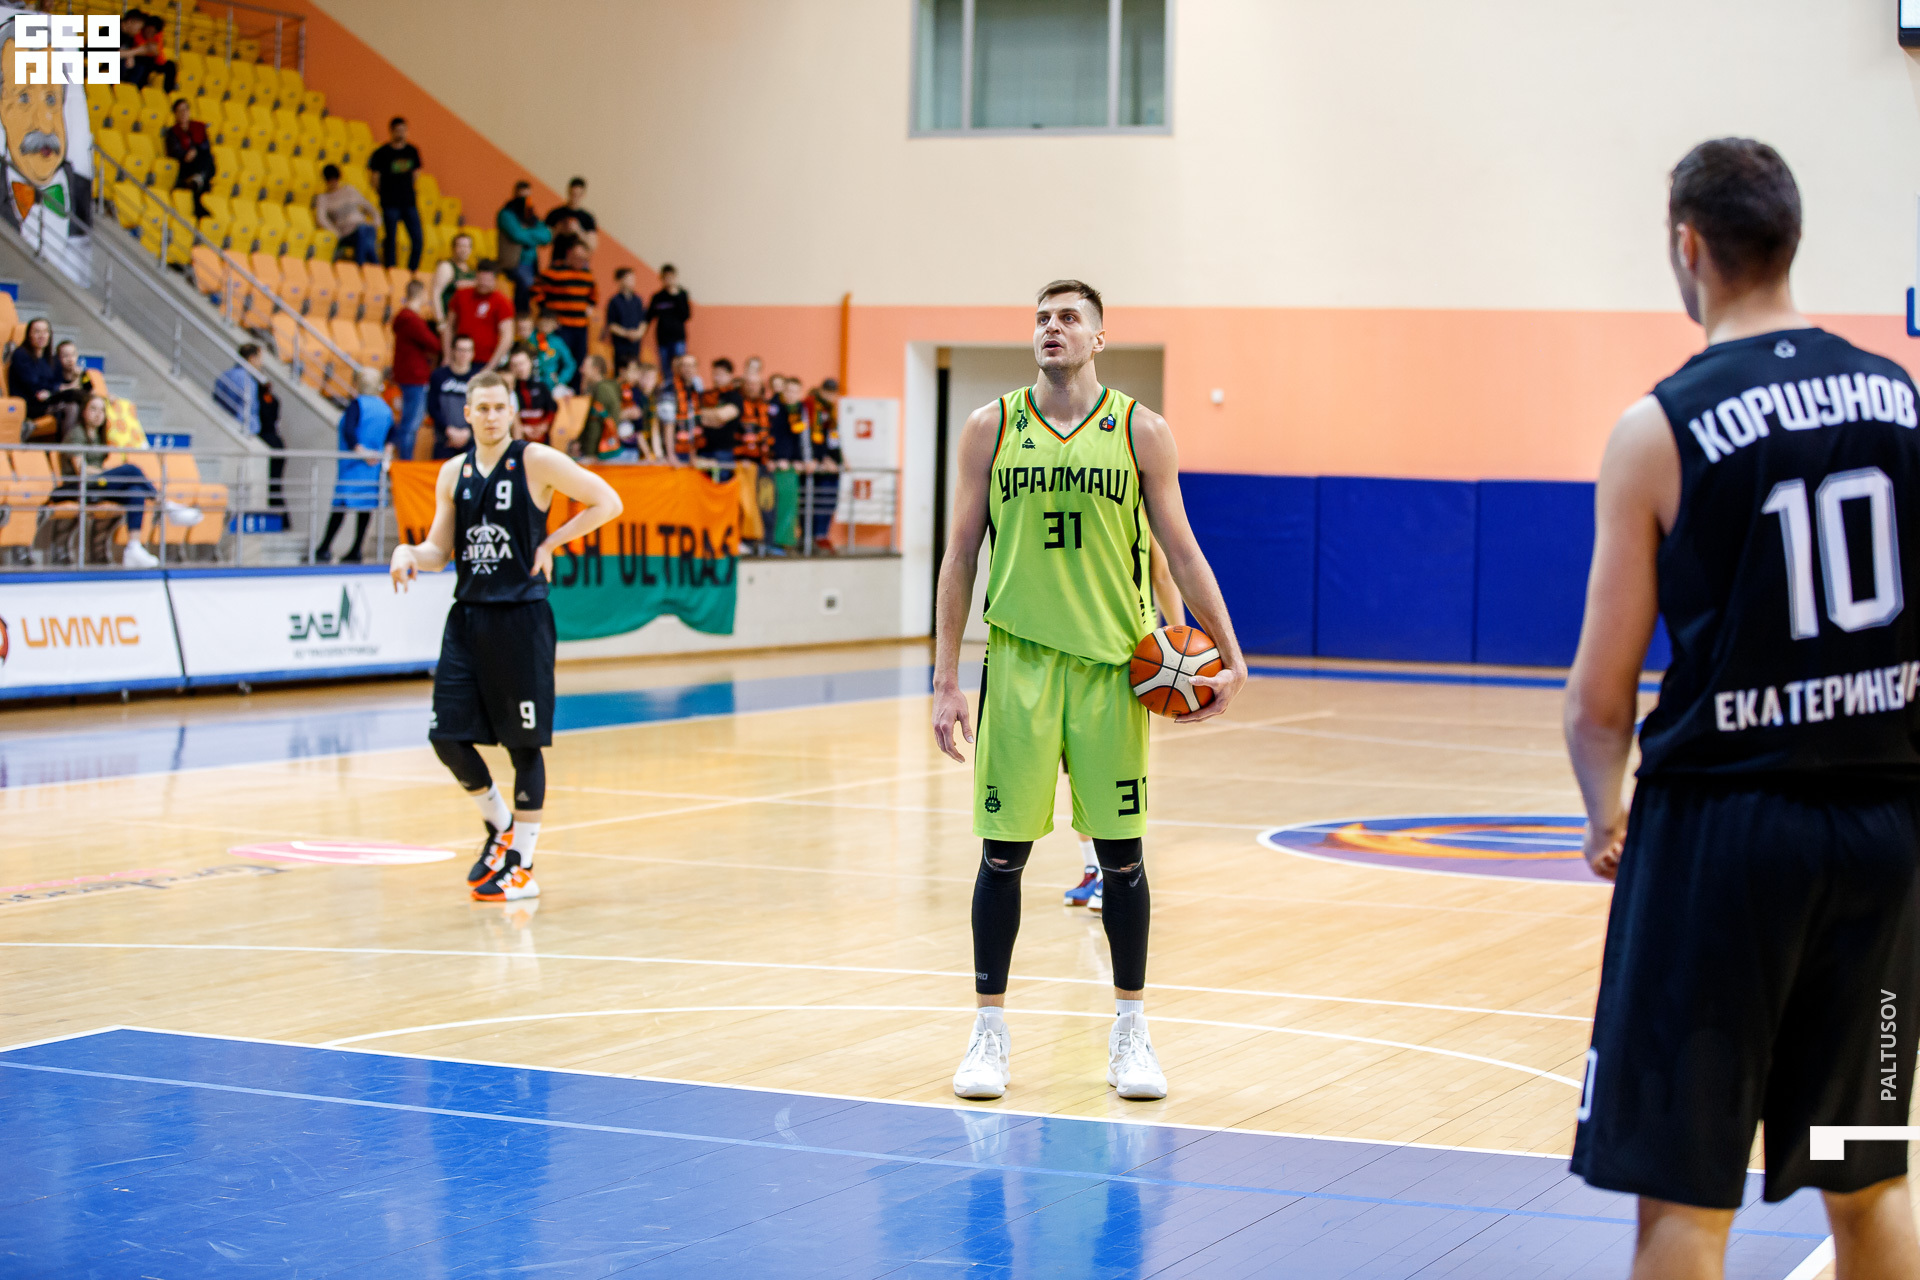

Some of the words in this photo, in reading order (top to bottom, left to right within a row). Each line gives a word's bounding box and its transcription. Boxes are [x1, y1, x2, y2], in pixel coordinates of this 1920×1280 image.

[1688, 372, 1918, 464] КОРШУНОВ
[495, 479, 513, 511] 9
[999, 466, 1129, 506] УРАЛМАШ
[1043, 511, 1083, 550] 31
[617, 521, 736, 588] ULTRAS
[1762, 466, 1905, 640] 10
[21, 616, 140, 648] UMMC
[520, 701, 536, 730] 9
[1714, 660, 1920, 732] ЕКАТЕРИНБ
